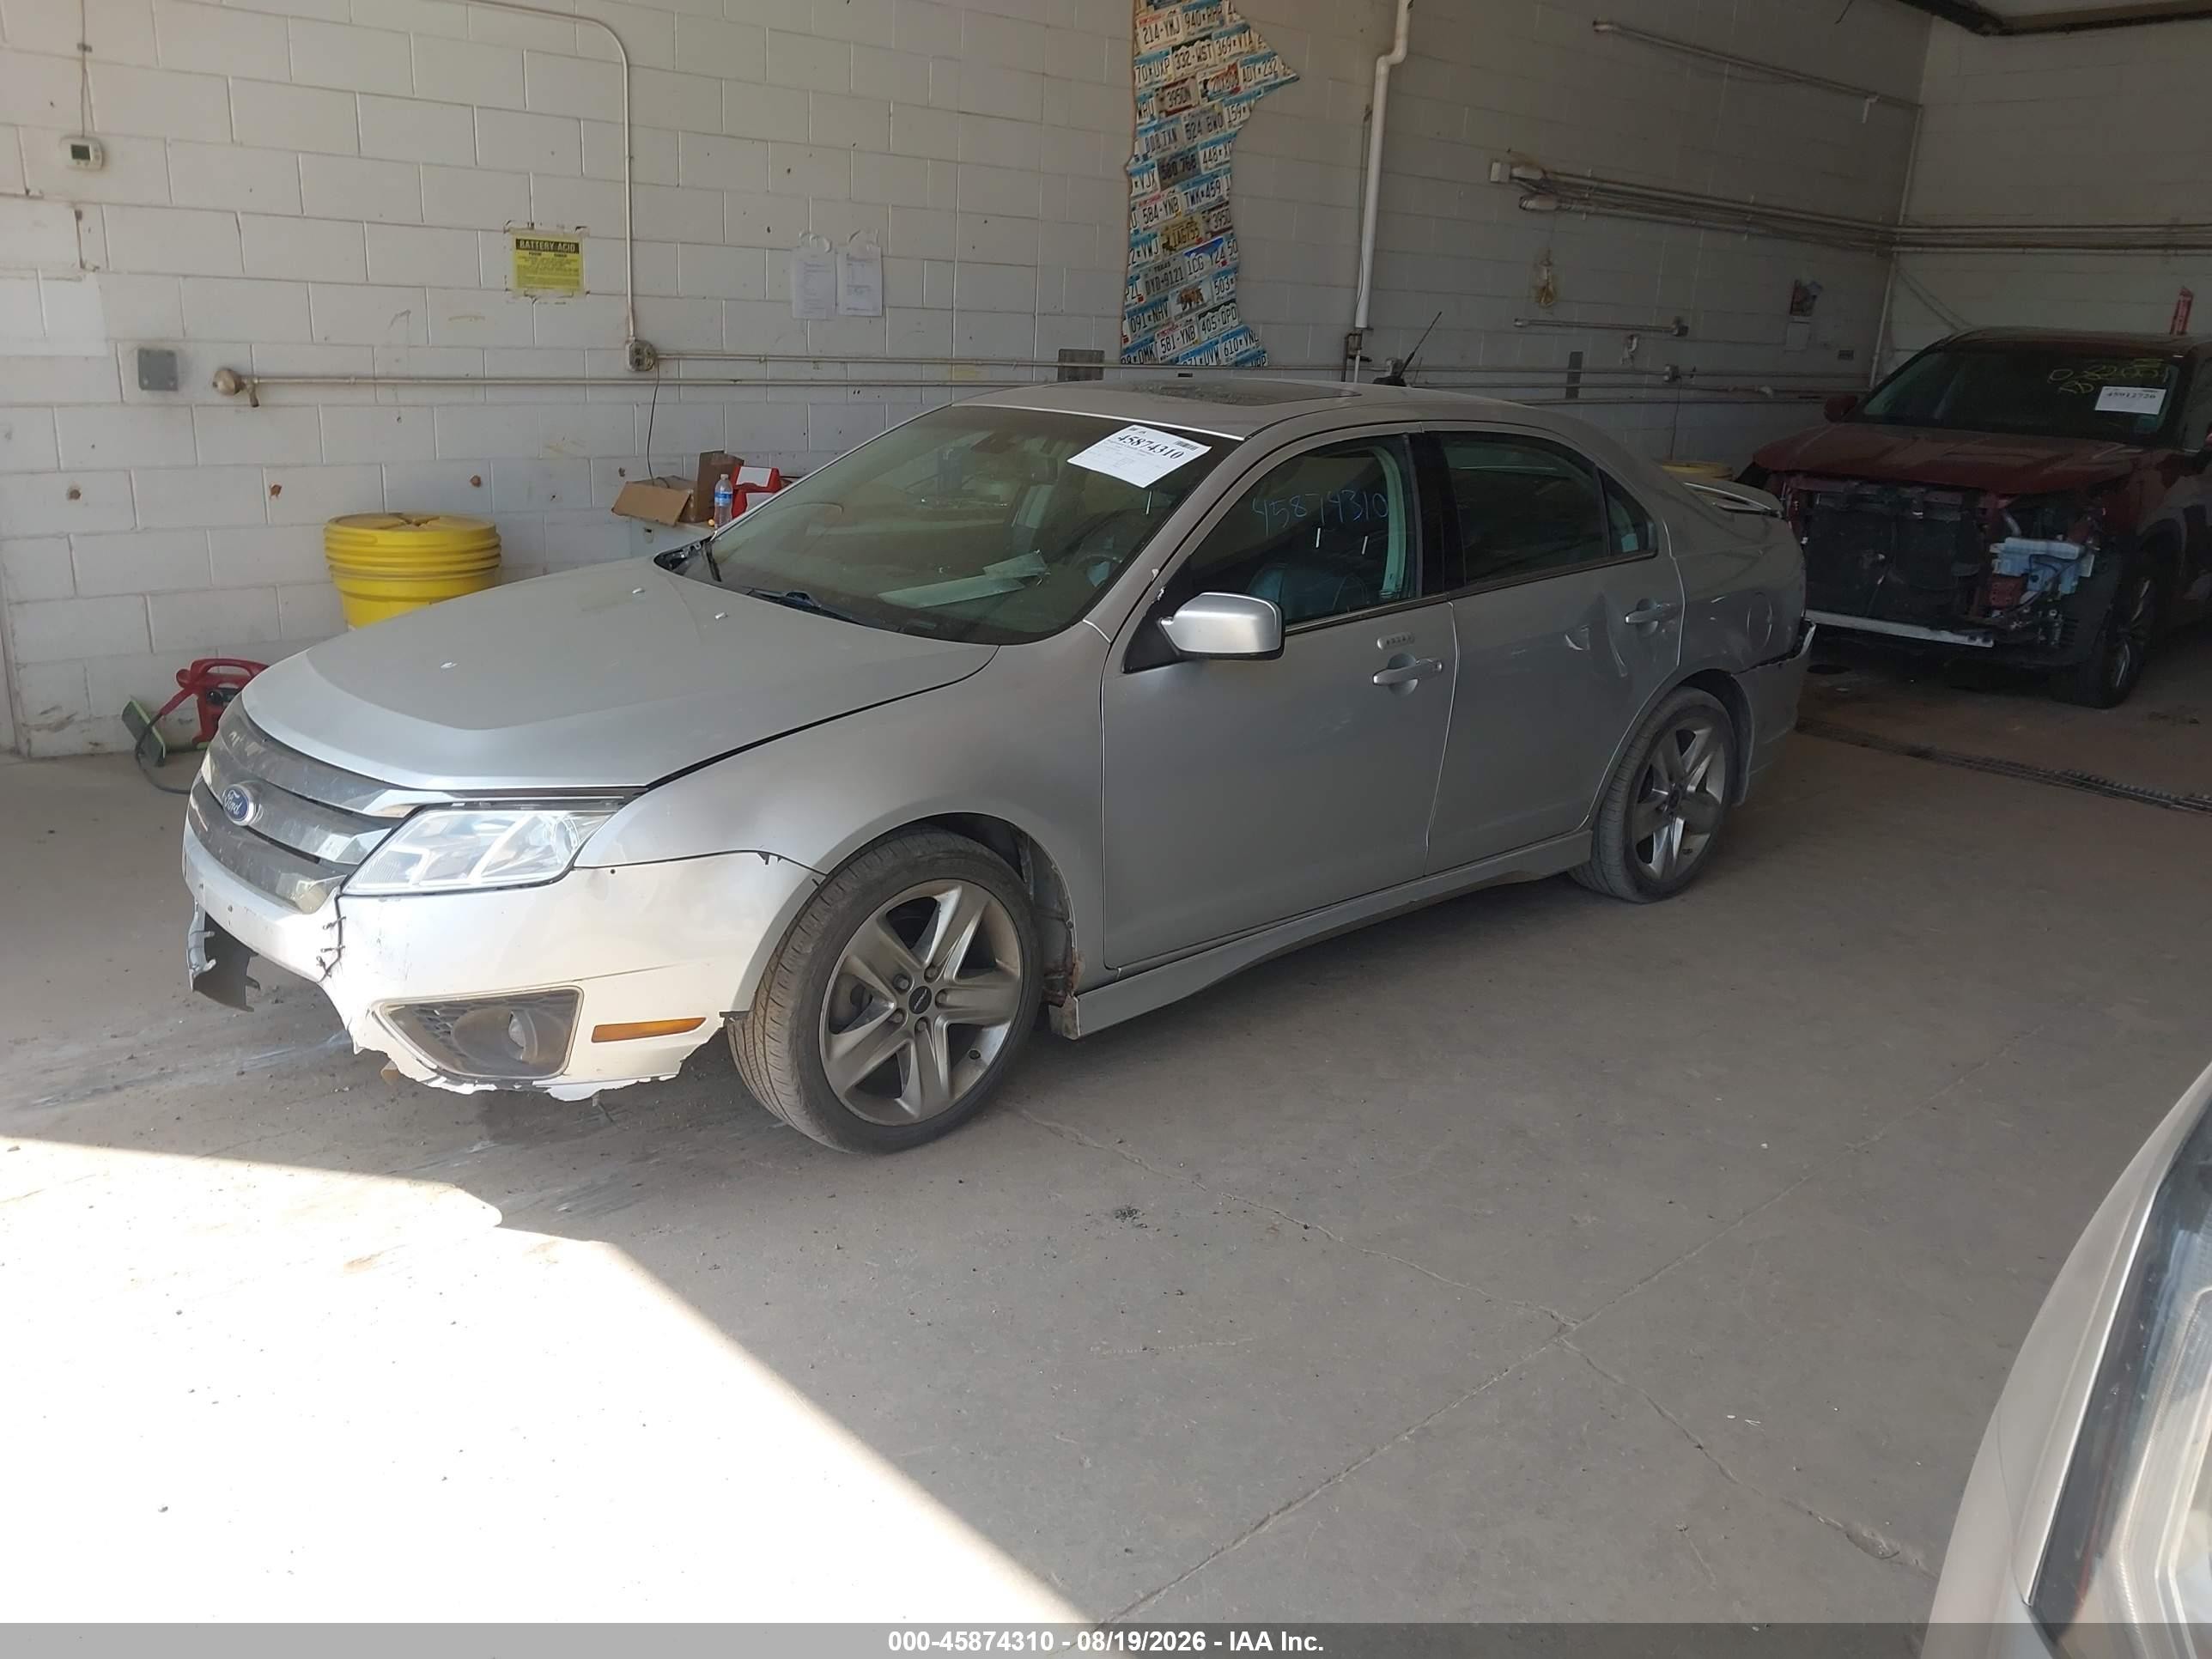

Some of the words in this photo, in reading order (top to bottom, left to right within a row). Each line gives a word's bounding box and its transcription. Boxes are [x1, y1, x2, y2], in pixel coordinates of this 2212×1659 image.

[520, 240, 554, 252] BATTERY
[557, 243, 575, 252] ACID
[1118, 434, 1184, 459] 45874310
[1252, 489, 1389, 536] 45874310
[224, 789, 243, 815] Ford
